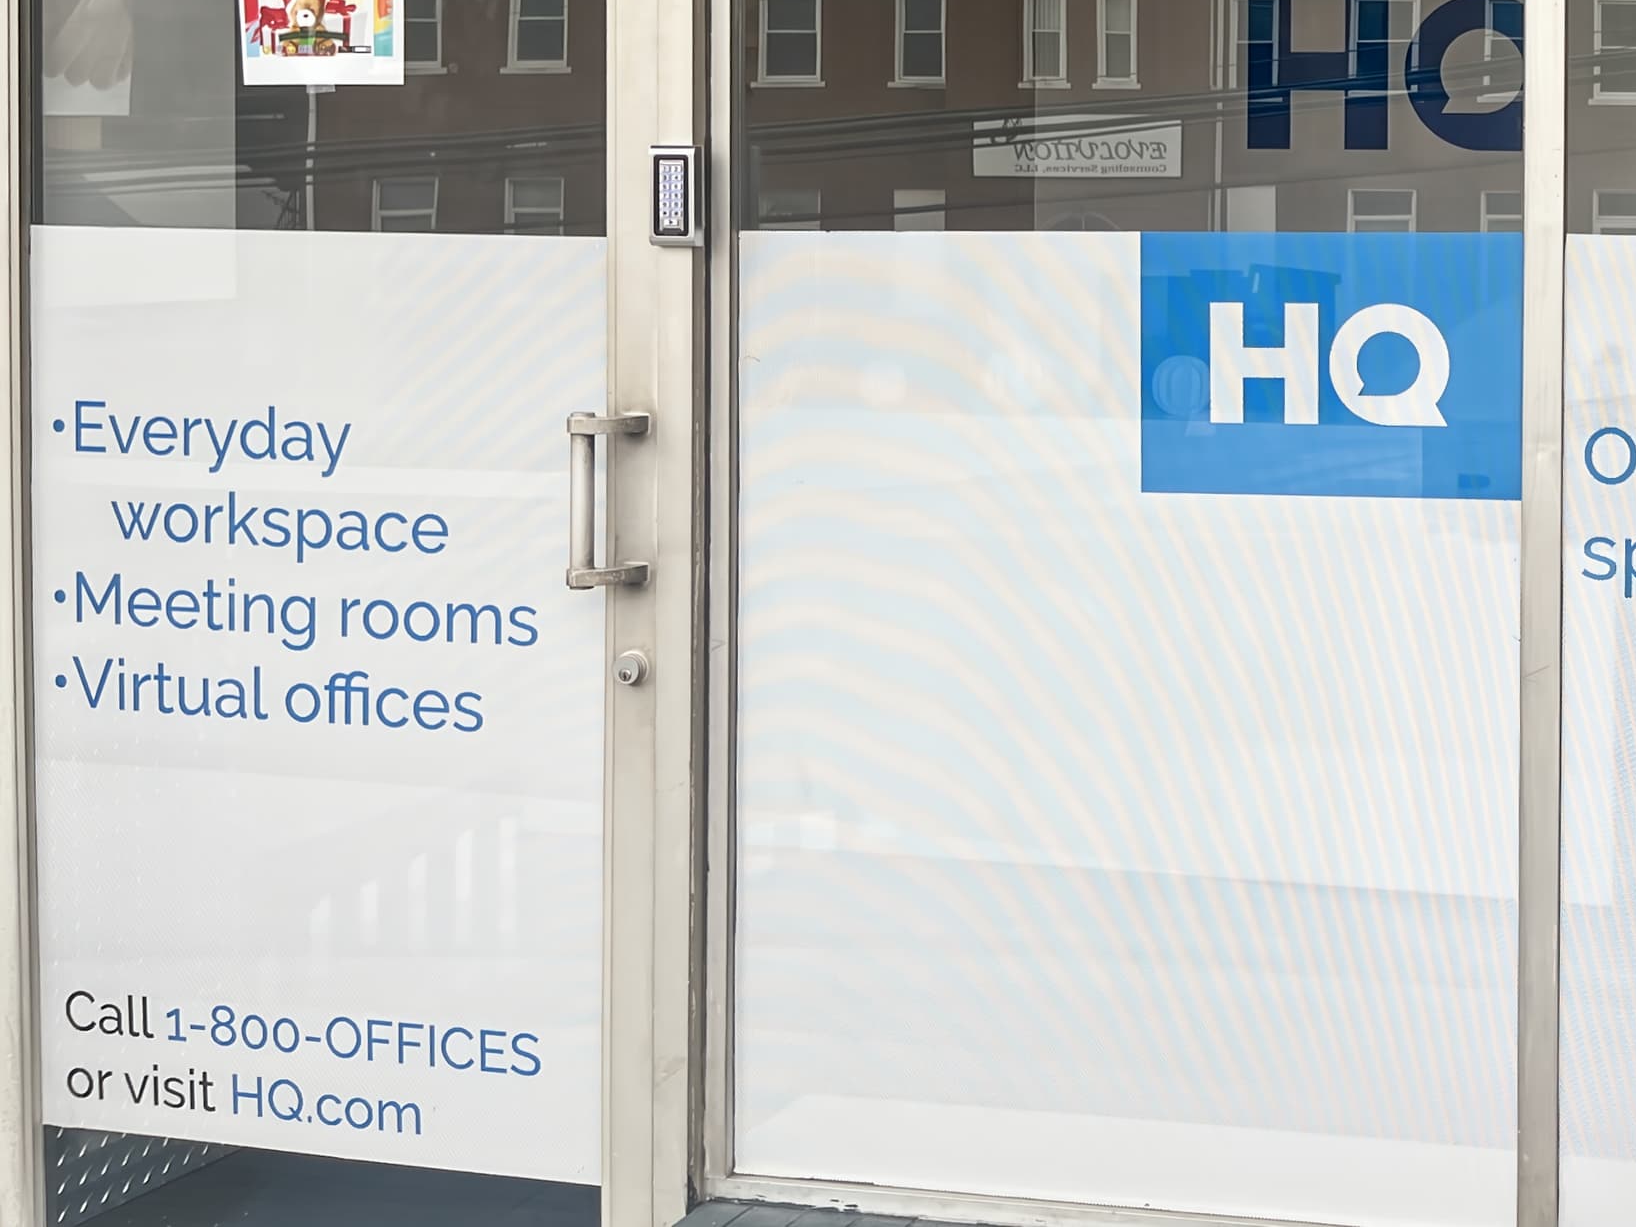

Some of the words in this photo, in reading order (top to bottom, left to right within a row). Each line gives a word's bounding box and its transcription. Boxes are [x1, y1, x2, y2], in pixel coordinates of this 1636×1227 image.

[1208, 302, 1451, 428] HQ
[75, 399, 352, 478] Everyday
[112, 492, 449, 563] workspace
[75, 572, 317, 651] Meeting
[340, 598, 539, 647] rooms
[73, 655, 269, 721] Virtual
[284, 669, 484, 733] offices
[64, 990, 155, 1040] Call
[165, 1003, 542, 1077] 1-800-OFFICES
[66, 1066, 113, 1101] or
[123, 1064, 216, 1113] visit
[231, 1073, 423, 1135] HQ.com
